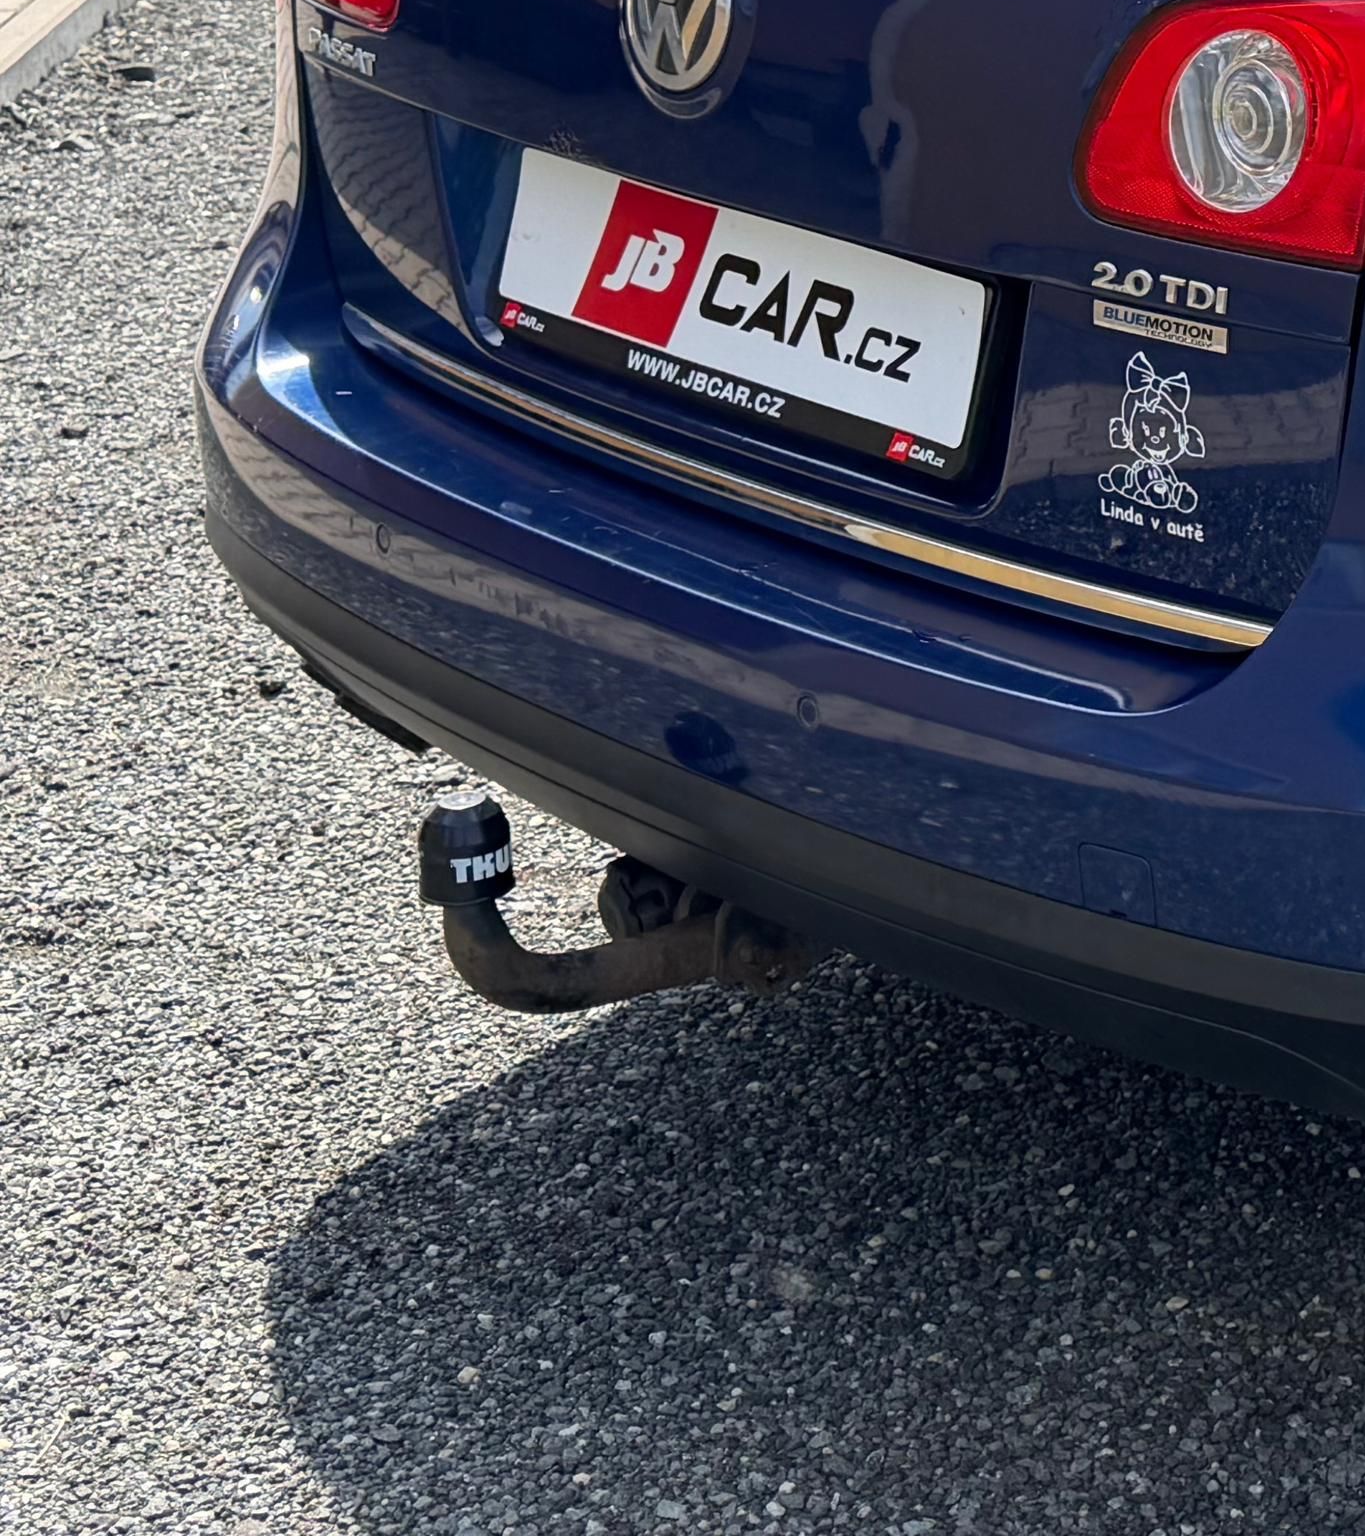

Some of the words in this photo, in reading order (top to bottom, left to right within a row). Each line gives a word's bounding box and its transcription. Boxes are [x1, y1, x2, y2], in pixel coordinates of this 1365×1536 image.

[601, 228, 686, 293] JB
[1091, 261, 1154, 298] 2.0
[1159, 274, 1229, 315] TDI
[1103, 306, 1214, 342] BLUEMOTION
[1144, 328, 1213, 349] TECHNOLOGY
[627, 349, 787, 419] WWW.JBCAR.CZ
[1101, 498, 1144, 527] Linda
[1150, 516, 1161, 531] v
[1166, 522, 1205, 543] autě
